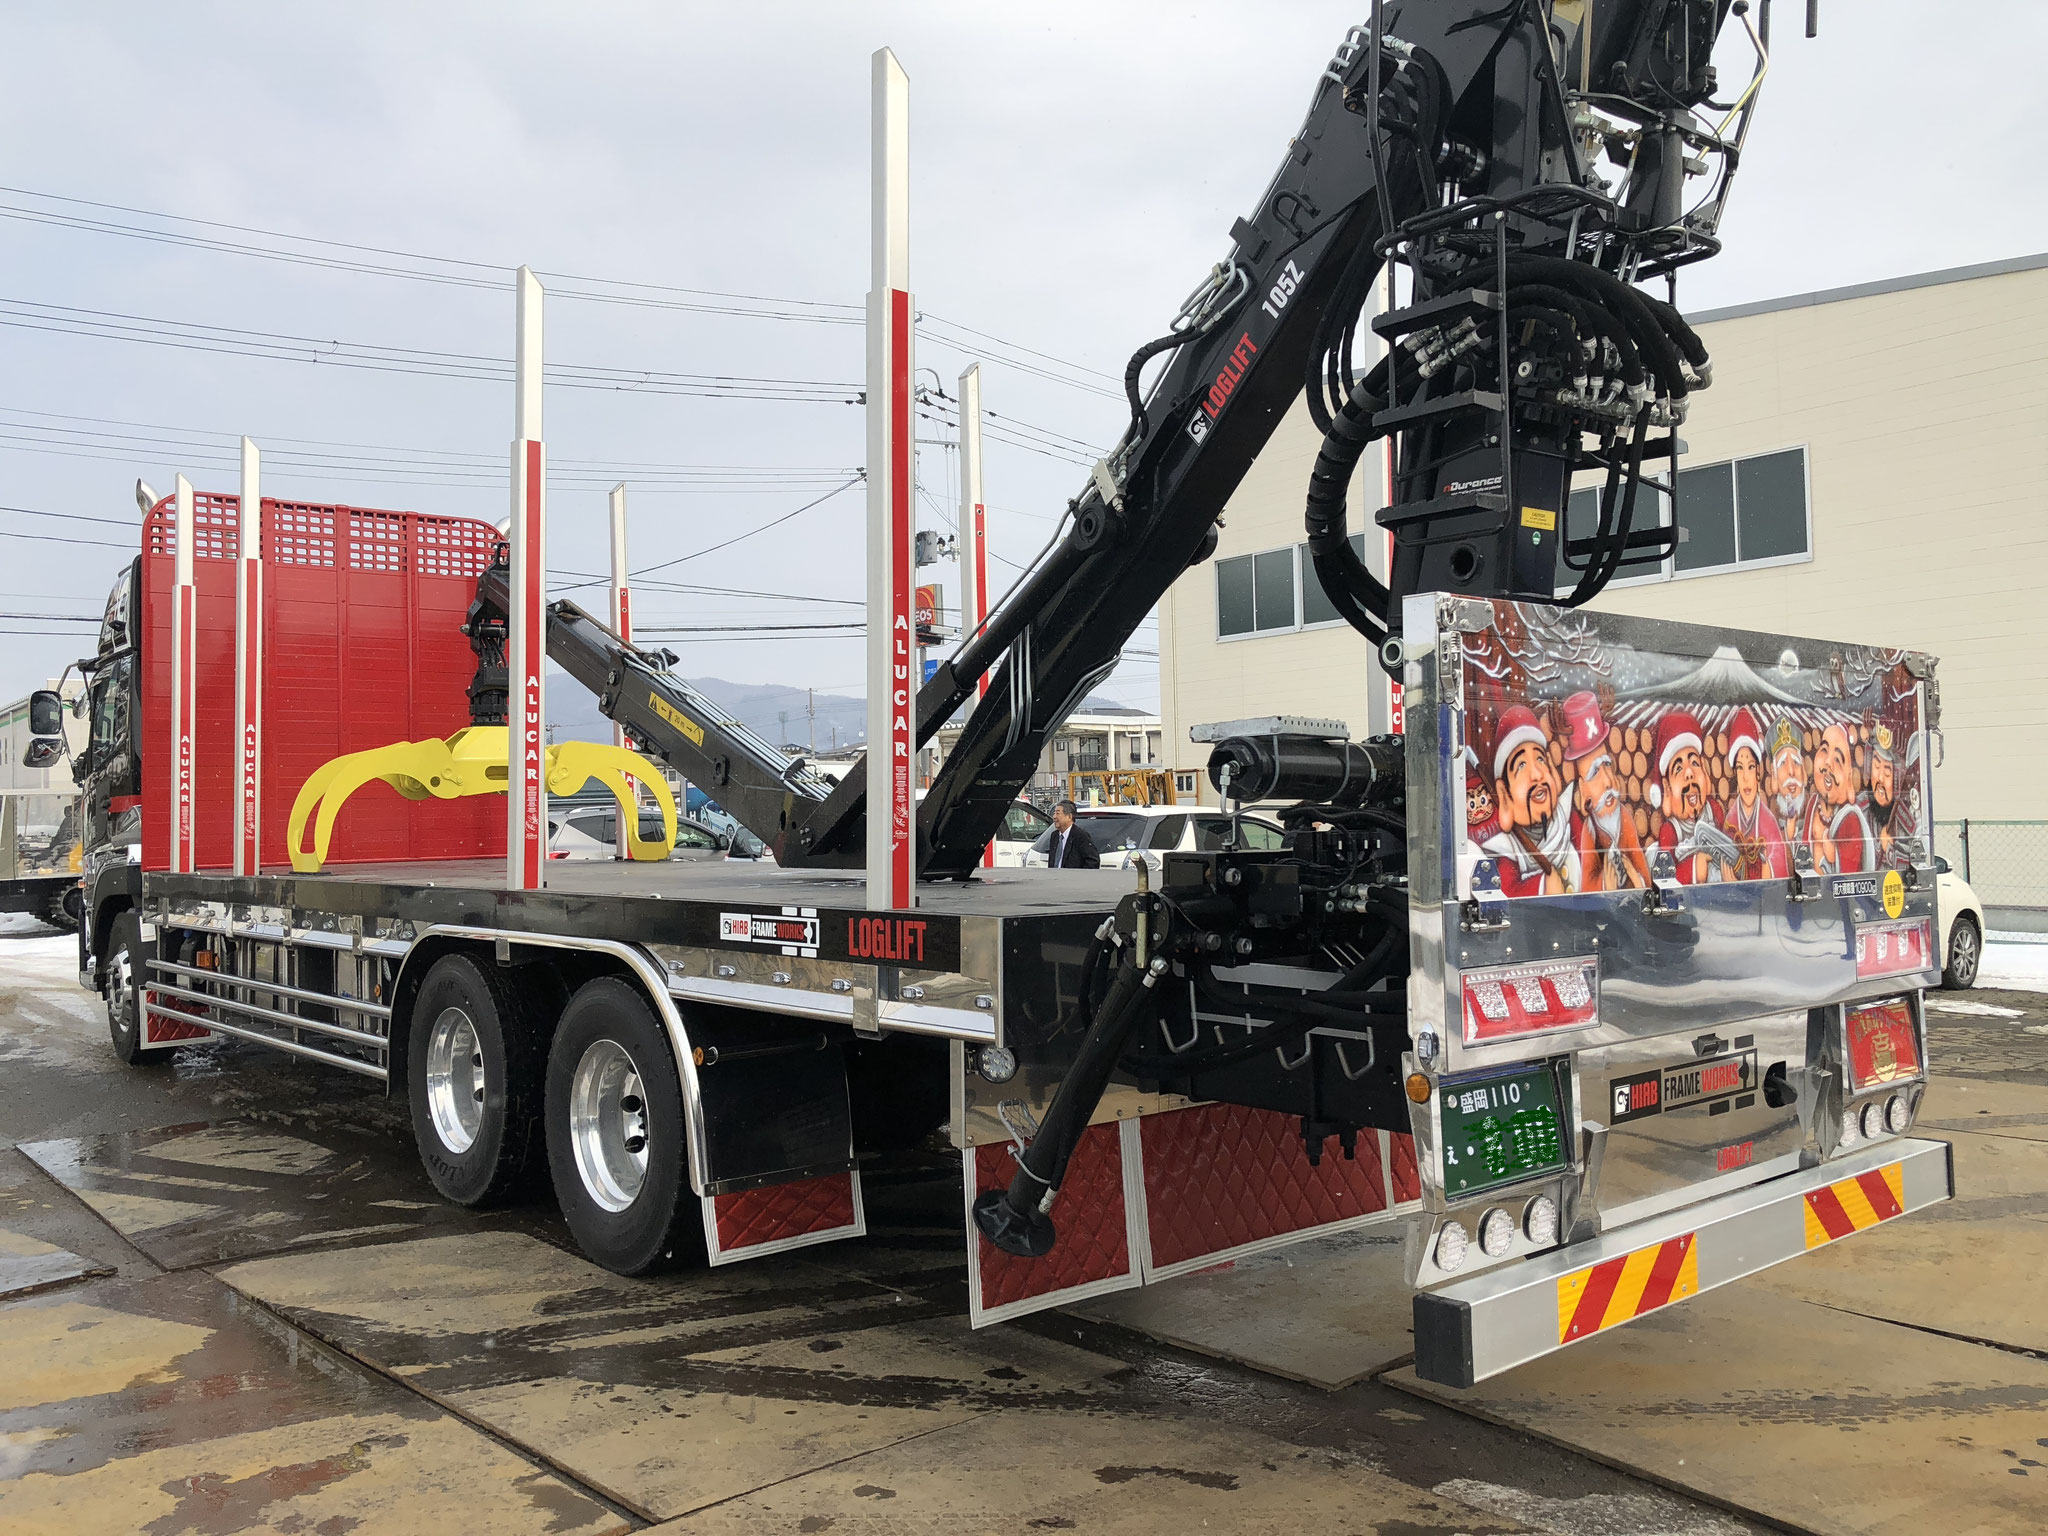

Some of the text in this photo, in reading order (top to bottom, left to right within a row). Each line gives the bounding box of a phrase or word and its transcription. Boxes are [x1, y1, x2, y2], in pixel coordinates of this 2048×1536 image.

[1262, 259, 1305, 320] 105Z
[1202, 332, 1258, 419] LOGLIFT
[916, 608, 932, 622] EOS
[894, 614, 908, 757] ALUCAR
[526, 675, 539, 780] ALUCAR
[181, 735, 190, 803] ALUCAR
[245, 724, 255, 798] ALUCAR
[732, 919, 749, 936] HIAB
[848, 917, 927, 961] LOGLIFT
[1631, 1080, 1658, 1110] HIAB
[1717, 1141, 1753, 1171] LOGLIFT
